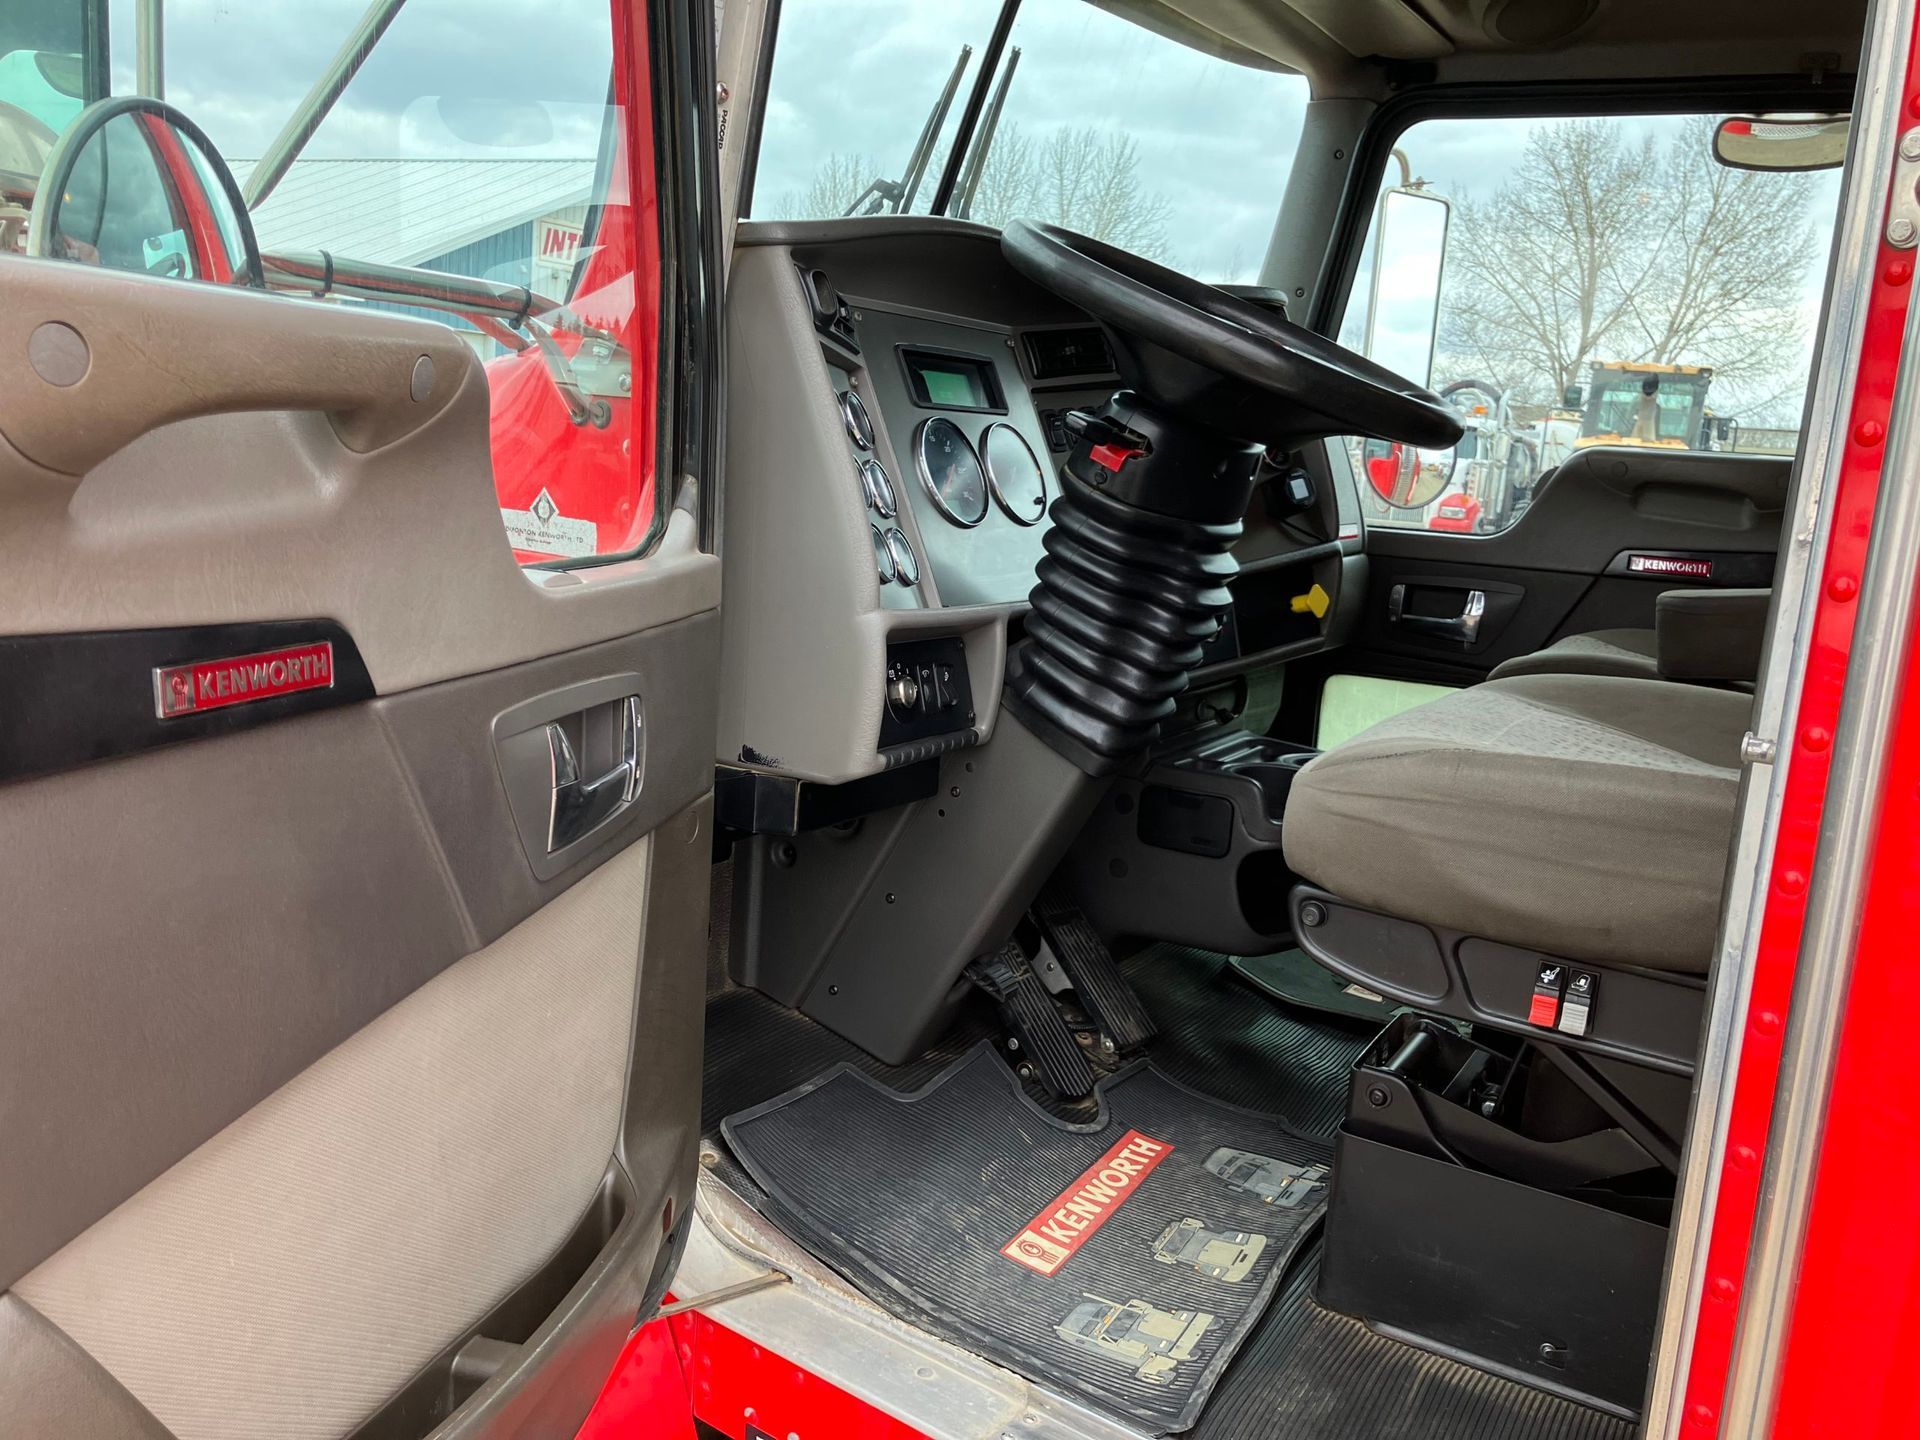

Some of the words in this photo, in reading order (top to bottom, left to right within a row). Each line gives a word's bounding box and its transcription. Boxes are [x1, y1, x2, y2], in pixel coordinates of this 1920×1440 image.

[542, 228, 582, 260] INT
[1645, 560, 1707, 573] KENWORTH
[198, 652, 328, 700] KENWORTH
[1040, 1137, 1162, 1244] KENWORTH
